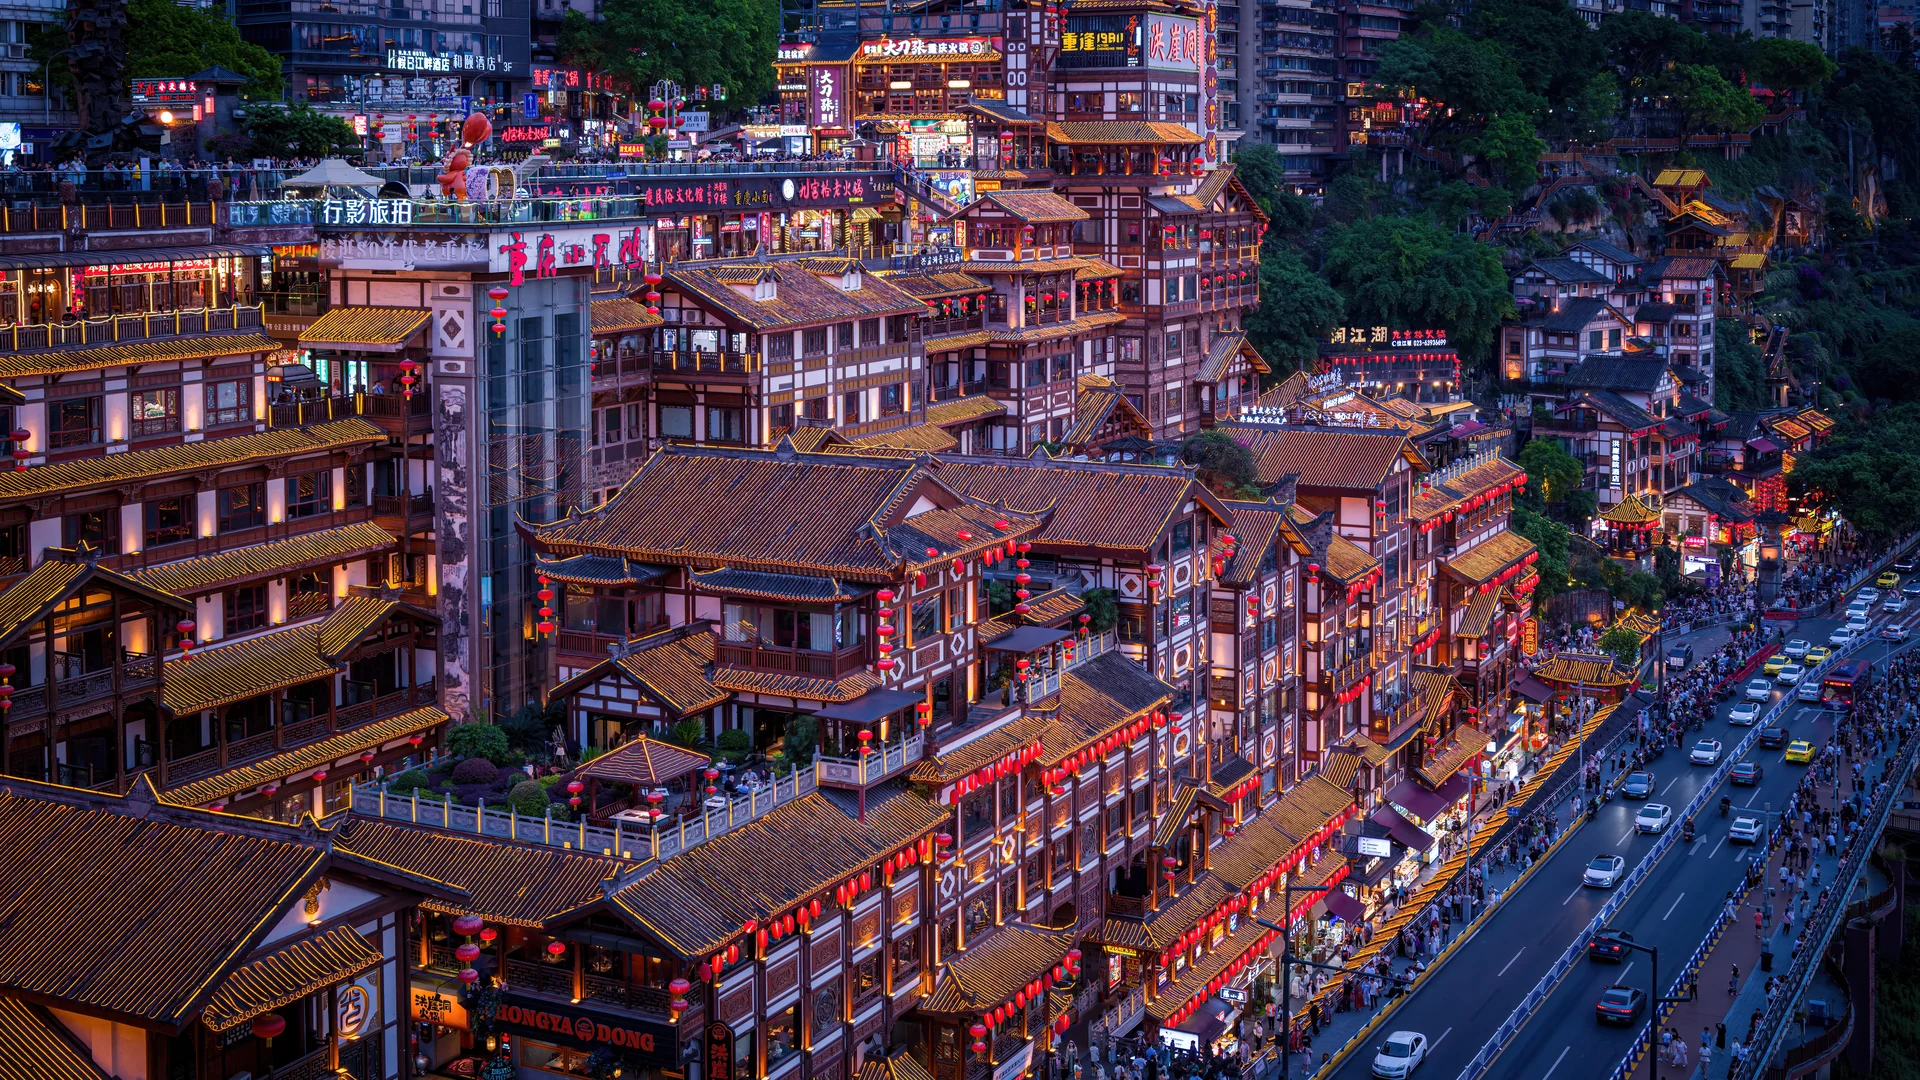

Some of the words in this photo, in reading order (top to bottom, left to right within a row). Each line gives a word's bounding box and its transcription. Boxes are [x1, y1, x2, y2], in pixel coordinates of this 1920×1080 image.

[1149, 21, 1197, 63] 洪崖洞
[453, 54, 496, 71] 和颐酒店
[503, 61, 512, 72] 3F
[819, 70, 834, 112] 大刀张
[799, 177, 864, 200] 九宫格老火锅
[323, 199, 412, 224] 行影旅拍
[1331, 326, 1388, 344] 闹江湖
[414, 993, 452, 1013] 洪崖洞
[494, 1003, 574, 1036] HONGYA
[597, 1024, 656, 1052] DONG
